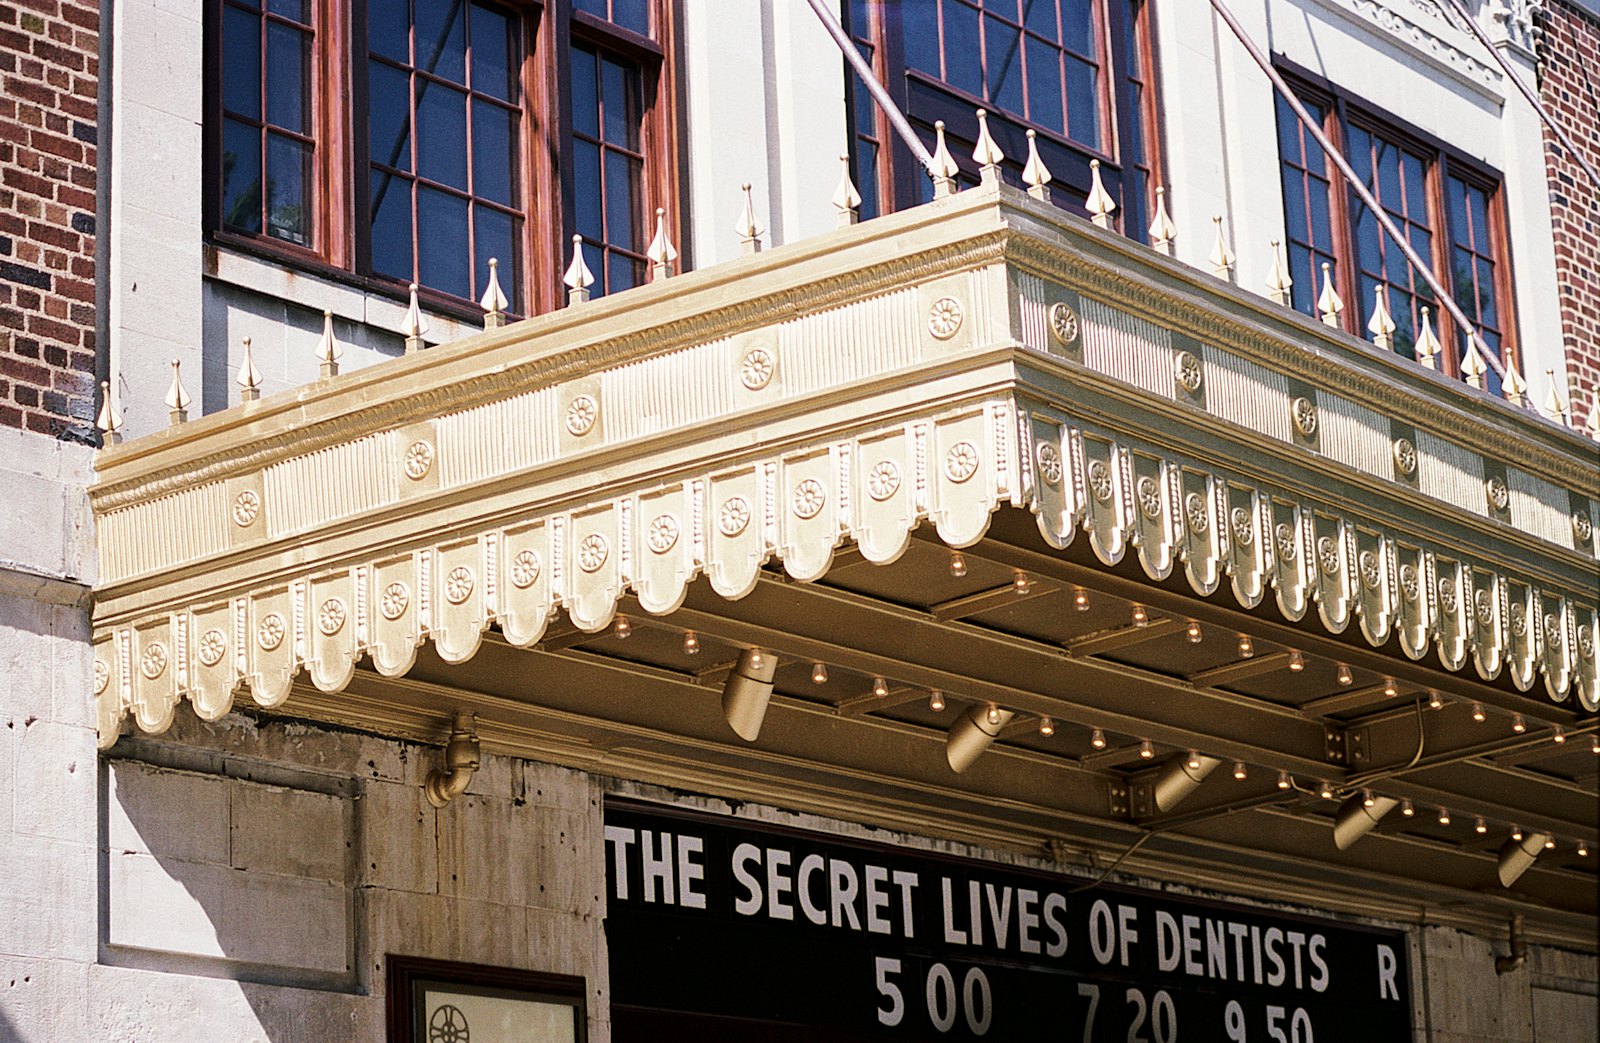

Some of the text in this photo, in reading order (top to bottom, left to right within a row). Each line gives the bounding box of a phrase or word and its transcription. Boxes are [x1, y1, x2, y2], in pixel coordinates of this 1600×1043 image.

[604, 825, 1400, 1001] THE SECRET LIVES OF DENTISTS R
[875, 956, 905, 1027] 5
